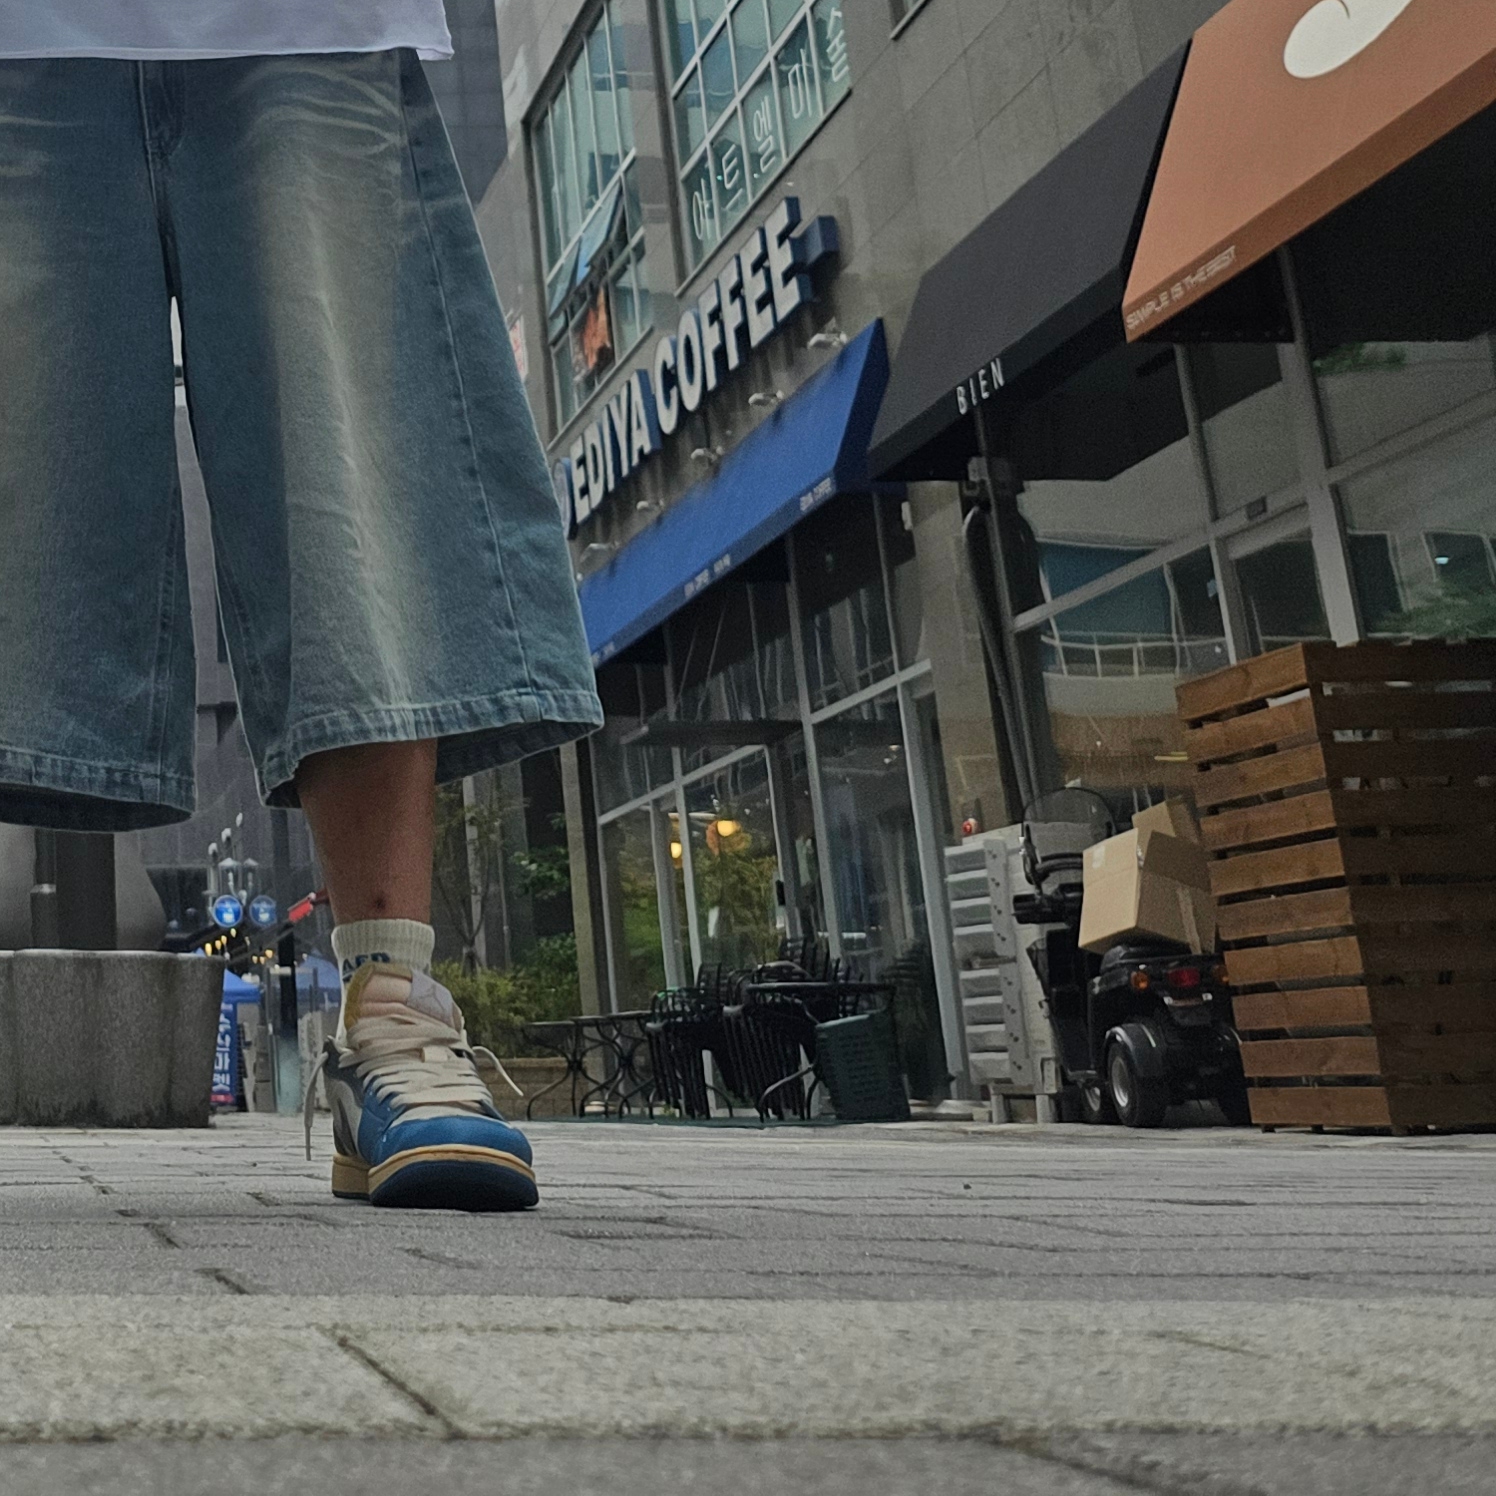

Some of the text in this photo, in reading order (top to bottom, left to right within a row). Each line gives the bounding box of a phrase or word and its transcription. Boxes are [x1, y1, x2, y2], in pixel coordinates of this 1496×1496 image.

[570, 370, 658, 525] EDIYA
[655, 196, 804, 436] COFFEE
[955, 357, 1005, 415] BIEN
